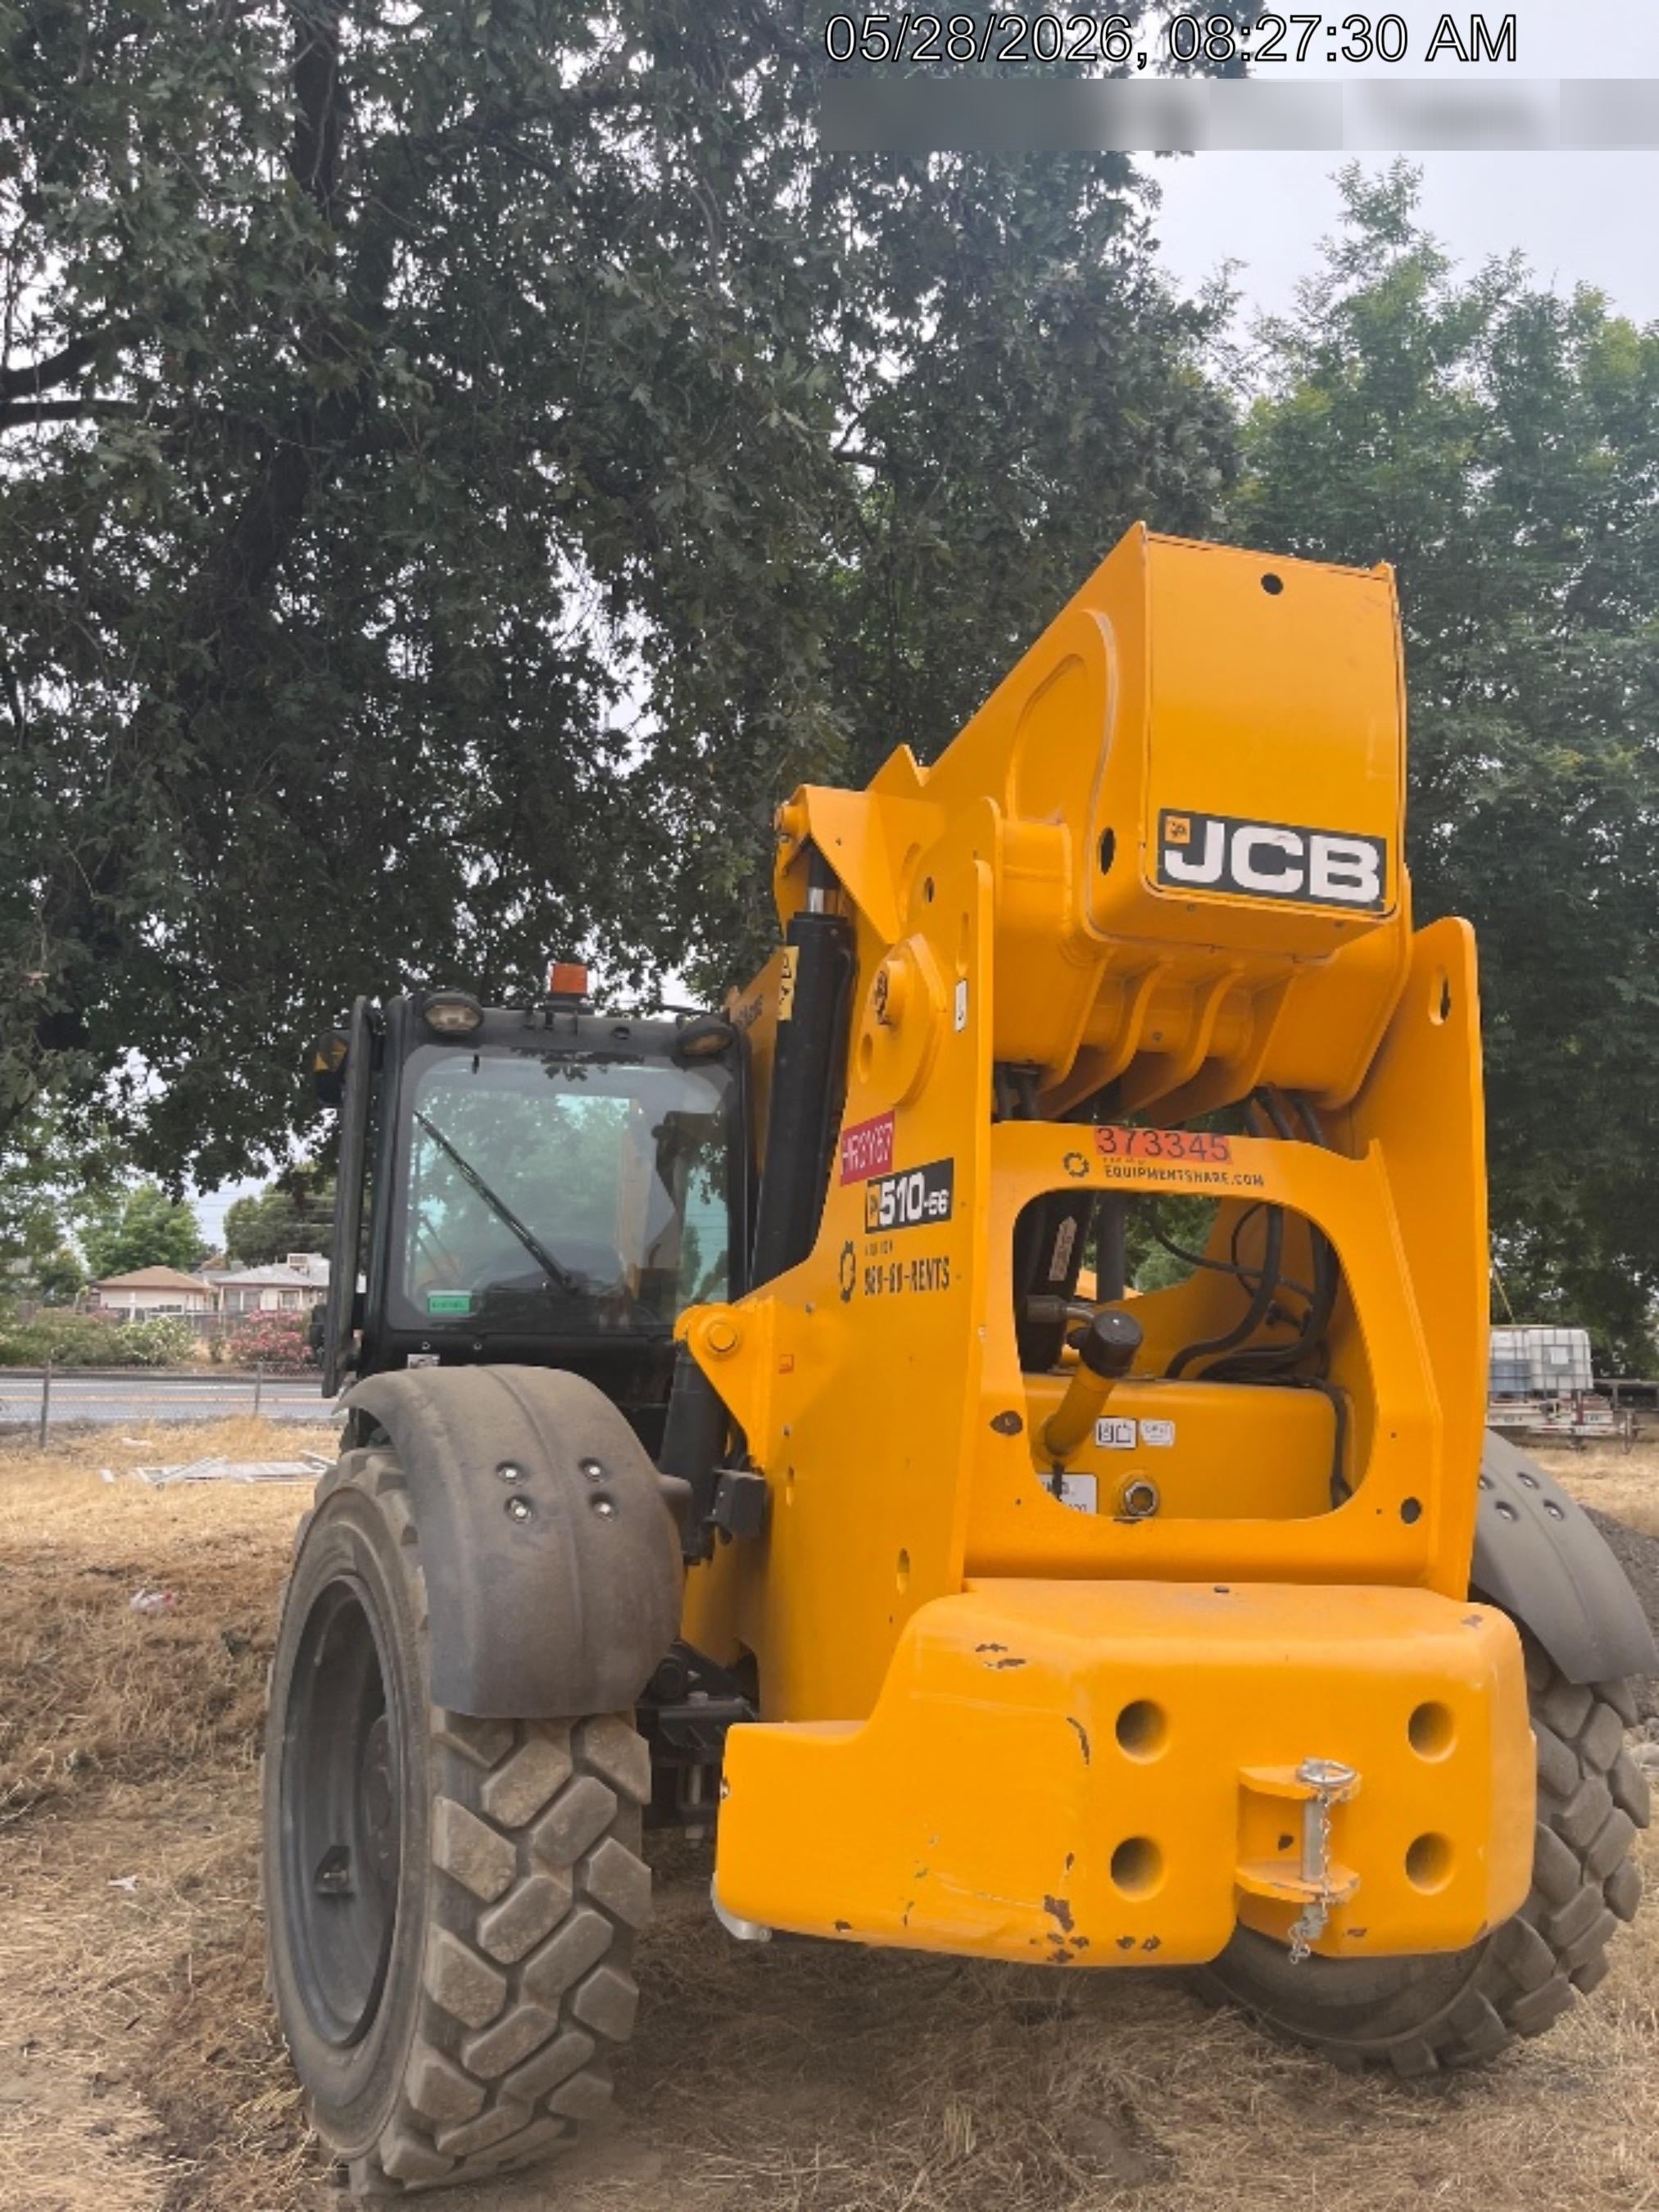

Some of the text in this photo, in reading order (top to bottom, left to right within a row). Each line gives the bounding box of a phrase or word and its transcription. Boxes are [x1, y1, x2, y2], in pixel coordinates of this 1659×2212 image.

[1164, 820, 1380, 903] JCB
[1098, 1127, 1231, 1162] 373345
[1105, 1166, 1264, 1186] EQUIPMENTSHARE.COM
[879, 1172, 950, 1226] 510-56
